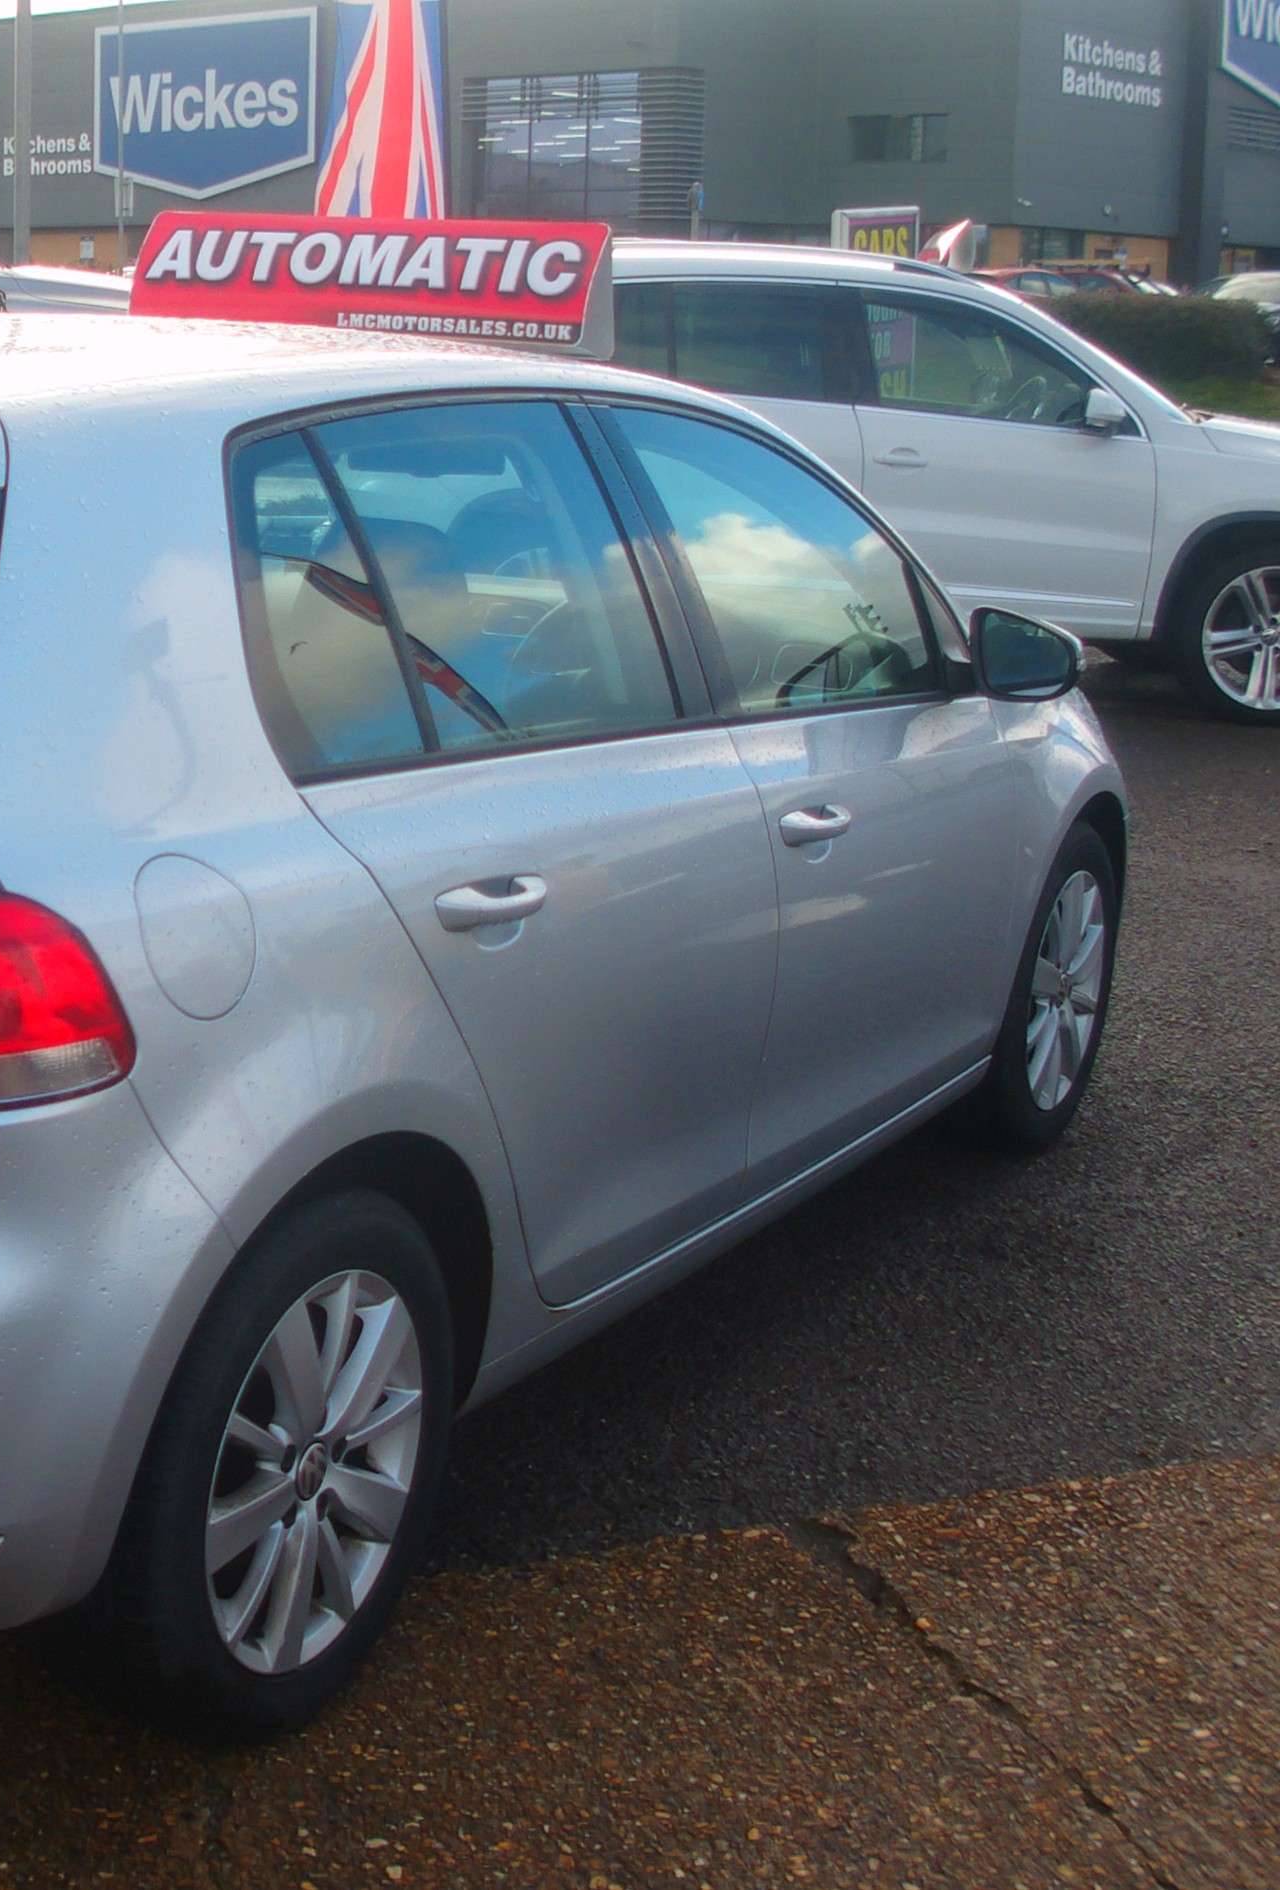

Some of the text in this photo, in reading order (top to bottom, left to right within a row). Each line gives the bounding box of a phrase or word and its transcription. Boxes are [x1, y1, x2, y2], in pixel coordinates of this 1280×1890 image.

[1063, 33, 1162, 76] Kitchens &
[110, 69, 298, 134] Wickes
[1061, 67, 1161, 108] Bathrooms
[3, 132, 91, 155] Kchens &
[3, 157, 92, 176] Bhrooms
[854, 225, 909, 256] CARS
[145, 230, 582, 297] AUTOMATIC
[337, 312, 572, 341] LMCMOTORSALES.CO.UK
